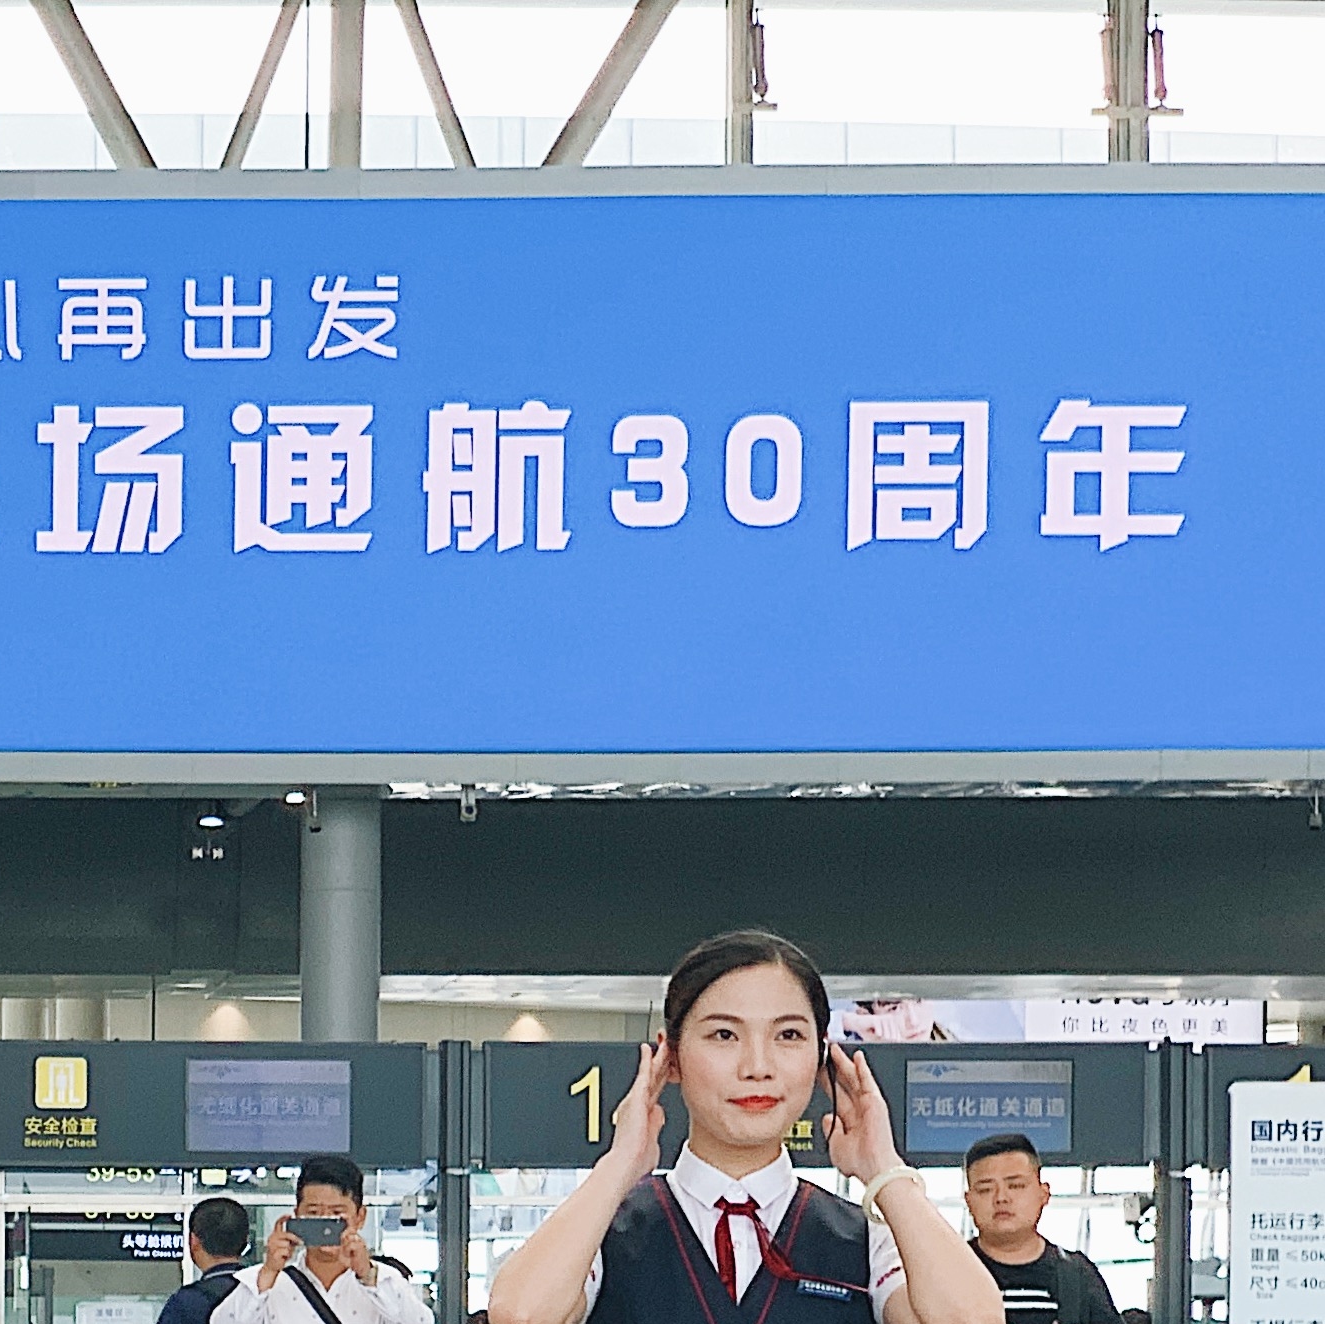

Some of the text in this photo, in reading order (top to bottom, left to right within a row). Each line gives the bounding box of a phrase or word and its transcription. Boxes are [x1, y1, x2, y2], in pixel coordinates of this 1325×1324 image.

[1062, 1016, 1229, 1035] 你比夜色更美
[912, 1096, 1065, 1117] 无纸化通关通道
[24, 1116, 98, 1136] 安全检查
[1251, 1120, 1324, 1142] 国内行
[24, 1137, 98, 1149] Security Check
[1252, 1212, 1325, 1231] 托运行李
[1250, 1275, 1279, 1291] 尺寸
